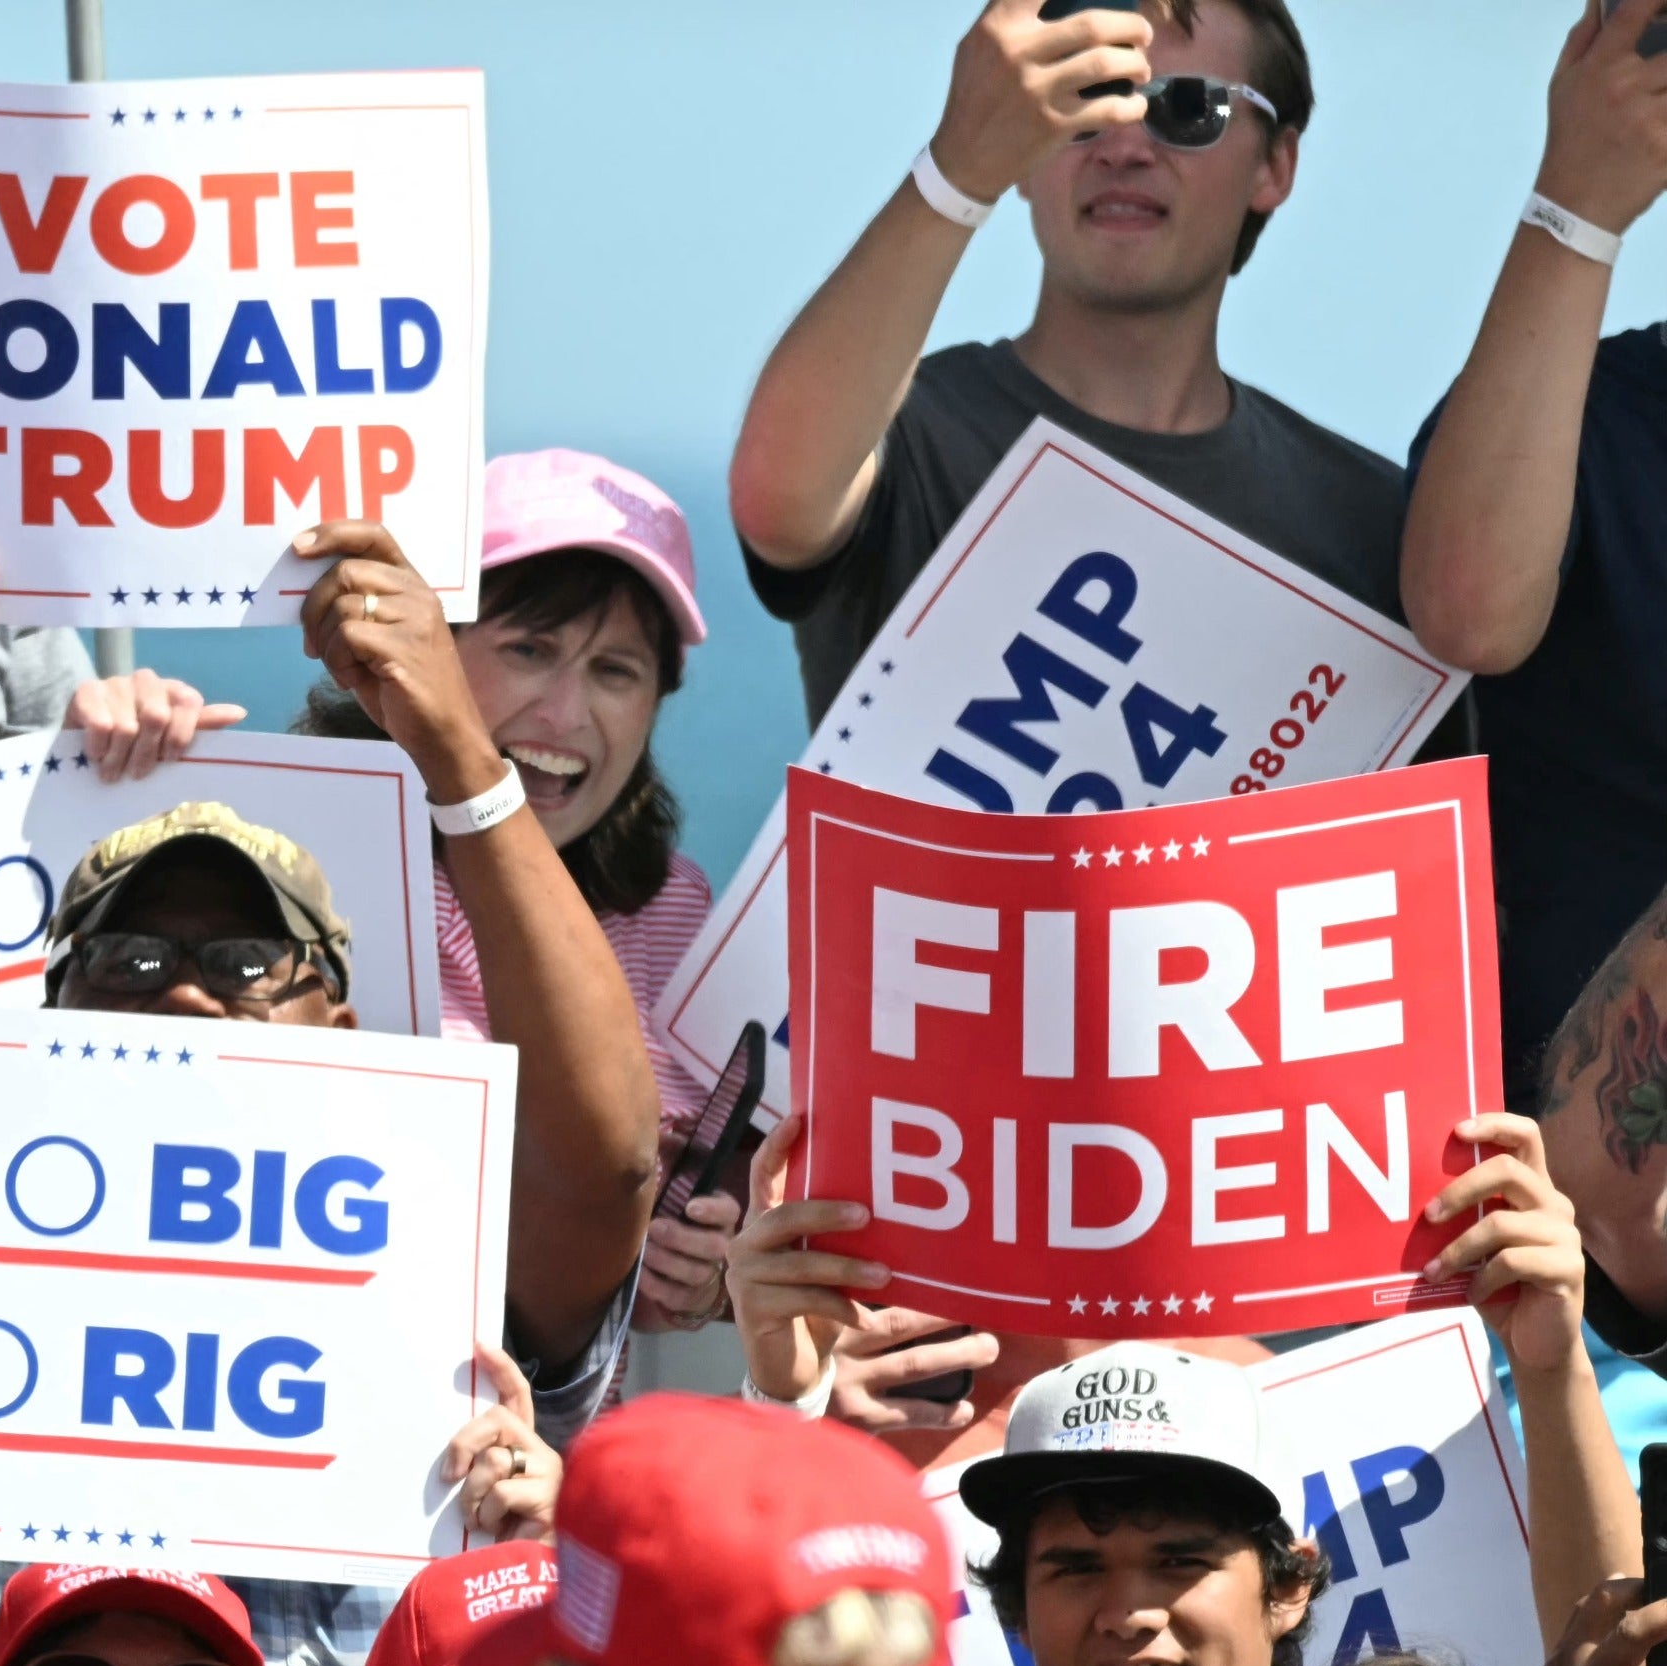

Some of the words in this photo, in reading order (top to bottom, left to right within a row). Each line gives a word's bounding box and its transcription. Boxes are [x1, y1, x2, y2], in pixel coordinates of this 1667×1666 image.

[869, 870, 1406, 1080] FIRE
[148, 1142, 390, 1257] BIG
[869, 1089, 1411, 1250] BIDEN
[80, 1325, 327, 1439] RIG
[1062, 1398, 1142, 1430] GUNS
[1147, 1399, 1171, 1424] &
[1075, 1366, 1158, 1400] GOD
[463, 1565, 529, 1599] MAKE
[467, 1585, 547, 1622] GREAT
